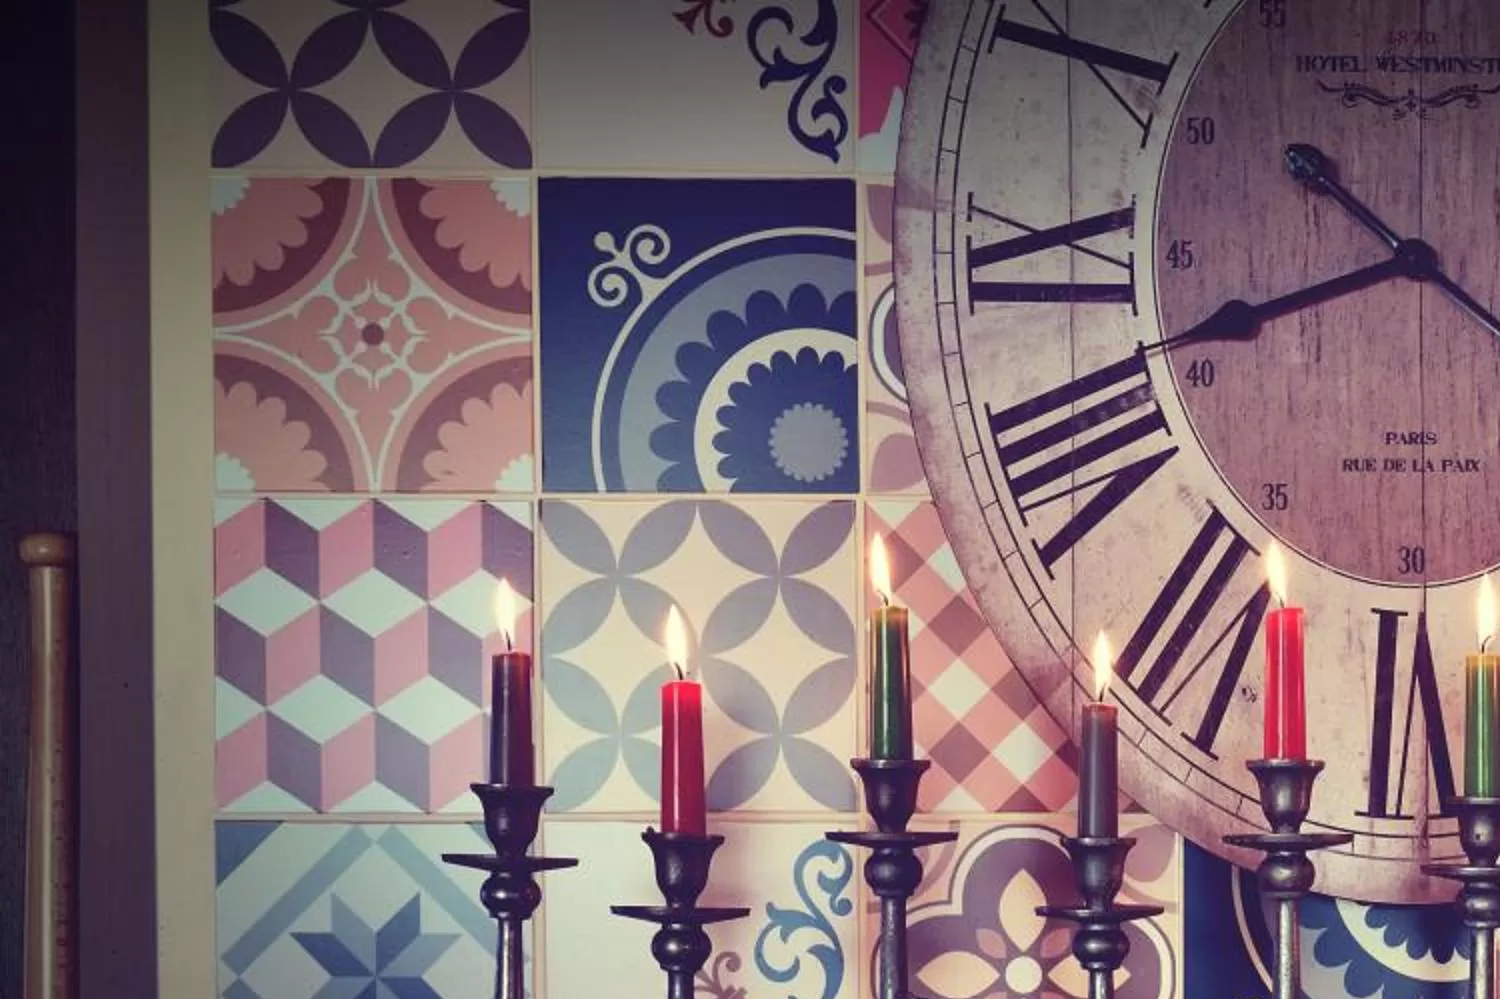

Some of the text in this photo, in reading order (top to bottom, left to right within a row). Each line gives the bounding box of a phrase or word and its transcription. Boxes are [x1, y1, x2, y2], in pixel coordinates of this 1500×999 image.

[1259, 0, 1287, 28] 55
[1296, 55, 1361, 73] HOTEL
[1186, 116, 1215, 145] 50
[1165, 240, 1193, 269] 45
[1186, 359, 1215, 387] 40
[1385, 431, 1438, 445] PARIS
[1342, 458, 1481, 473] RUE DE LA PAIX
[1261, 483, 1289, 511] 35
[1397, 546, 1425, 575] 30
